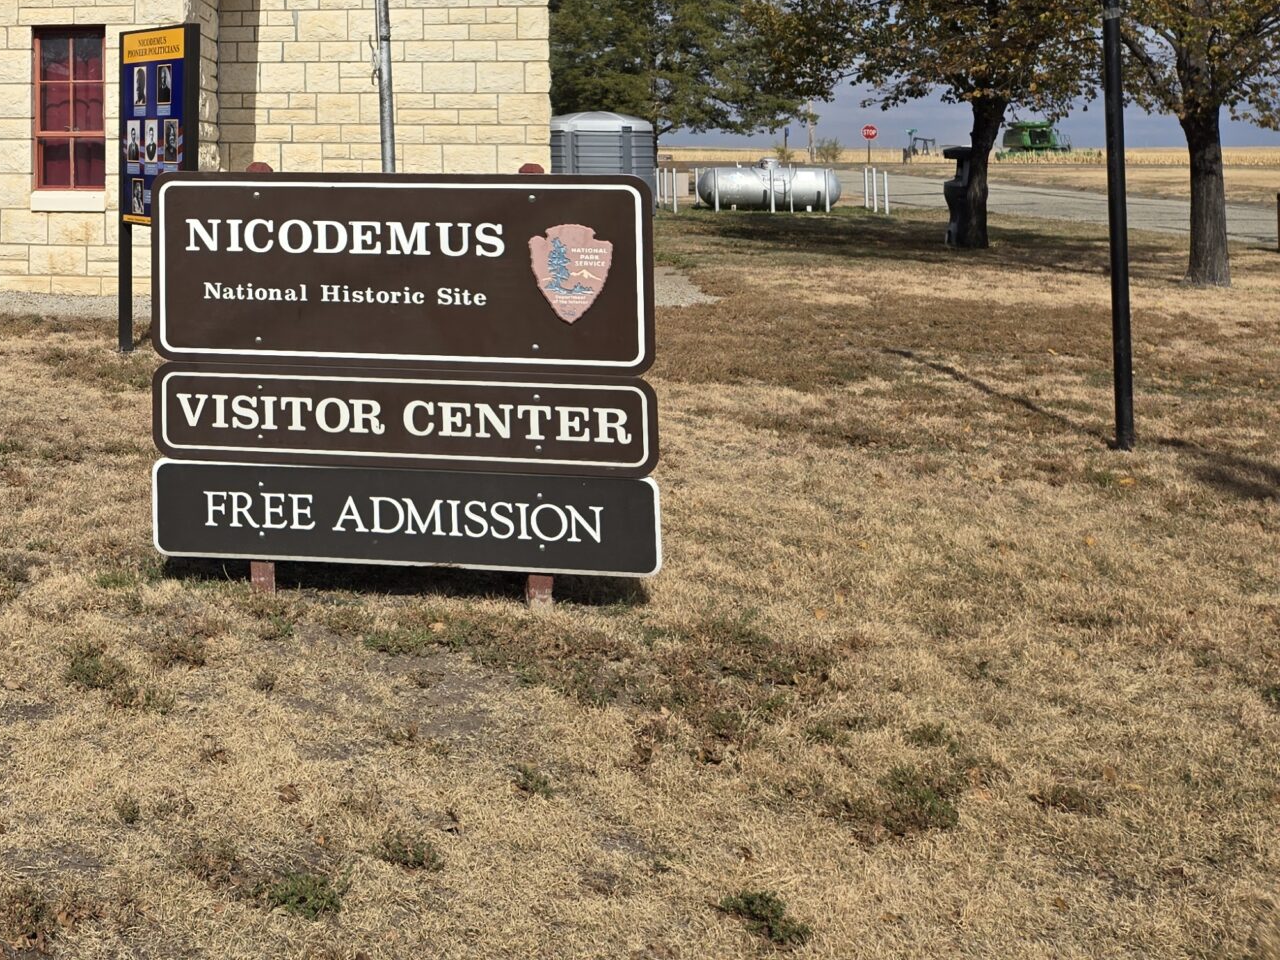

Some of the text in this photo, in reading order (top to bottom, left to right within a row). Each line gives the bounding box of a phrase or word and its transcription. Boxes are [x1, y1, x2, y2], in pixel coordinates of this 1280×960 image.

[127, 44, 180, 59] PIONEER POLITICIANS
[138, 36, 167, 46] NICODEMUS
[185, 218, 505, 258] NICODEMUS
[203, 281, 487, 306] National Historic Site
[176, 392, 632, 445] VISITOR CENTER
[203, 490, 604, 543] FREE ADMISSION
